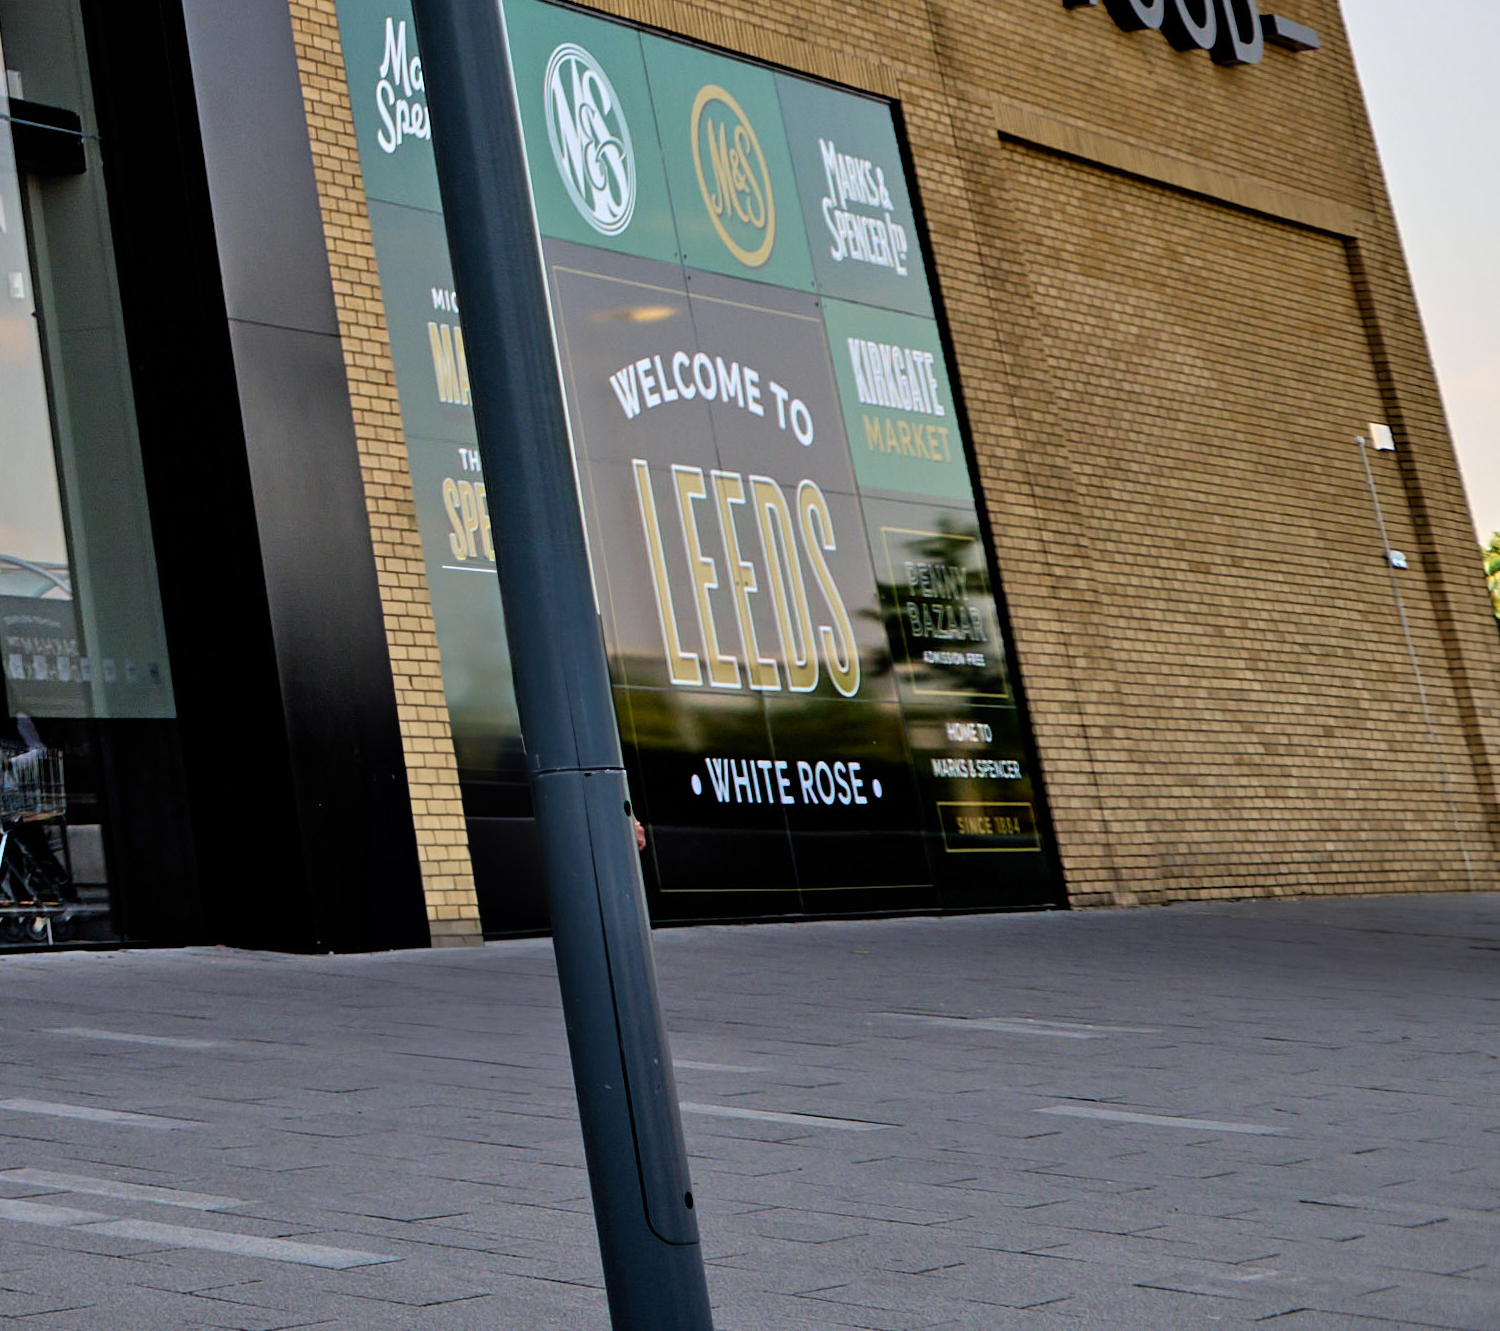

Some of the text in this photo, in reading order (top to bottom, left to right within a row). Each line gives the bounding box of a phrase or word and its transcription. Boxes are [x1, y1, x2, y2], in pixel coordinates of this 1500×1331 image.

[550, 51, 633, 226] M&S
[707, 117, 766, 229] M&S
[819, 138, 895, 212] MARKS &
[822, 197, 895, 268] SPENCER
[609, 351, 814, 446] WELCOME TO
[848, 337, 946, 416] KIRKGATE
[862, 414, 952, 463] MARKET
[631, 458, 861, 698] LEEDS
[904, 561, 969, 601] PENNY
[906, 601, 988, 643] BAZAAR
[965, 652, 987, 667] FREE
[945, 722, 993, 743] HOME TO
[704, 757, 868, 806] WHITE ROSE
[930, 757, 967, 778] MARKS
[977, 759, 1023, 779] SPENCER
[955, 816, 993, 835] SINCE
